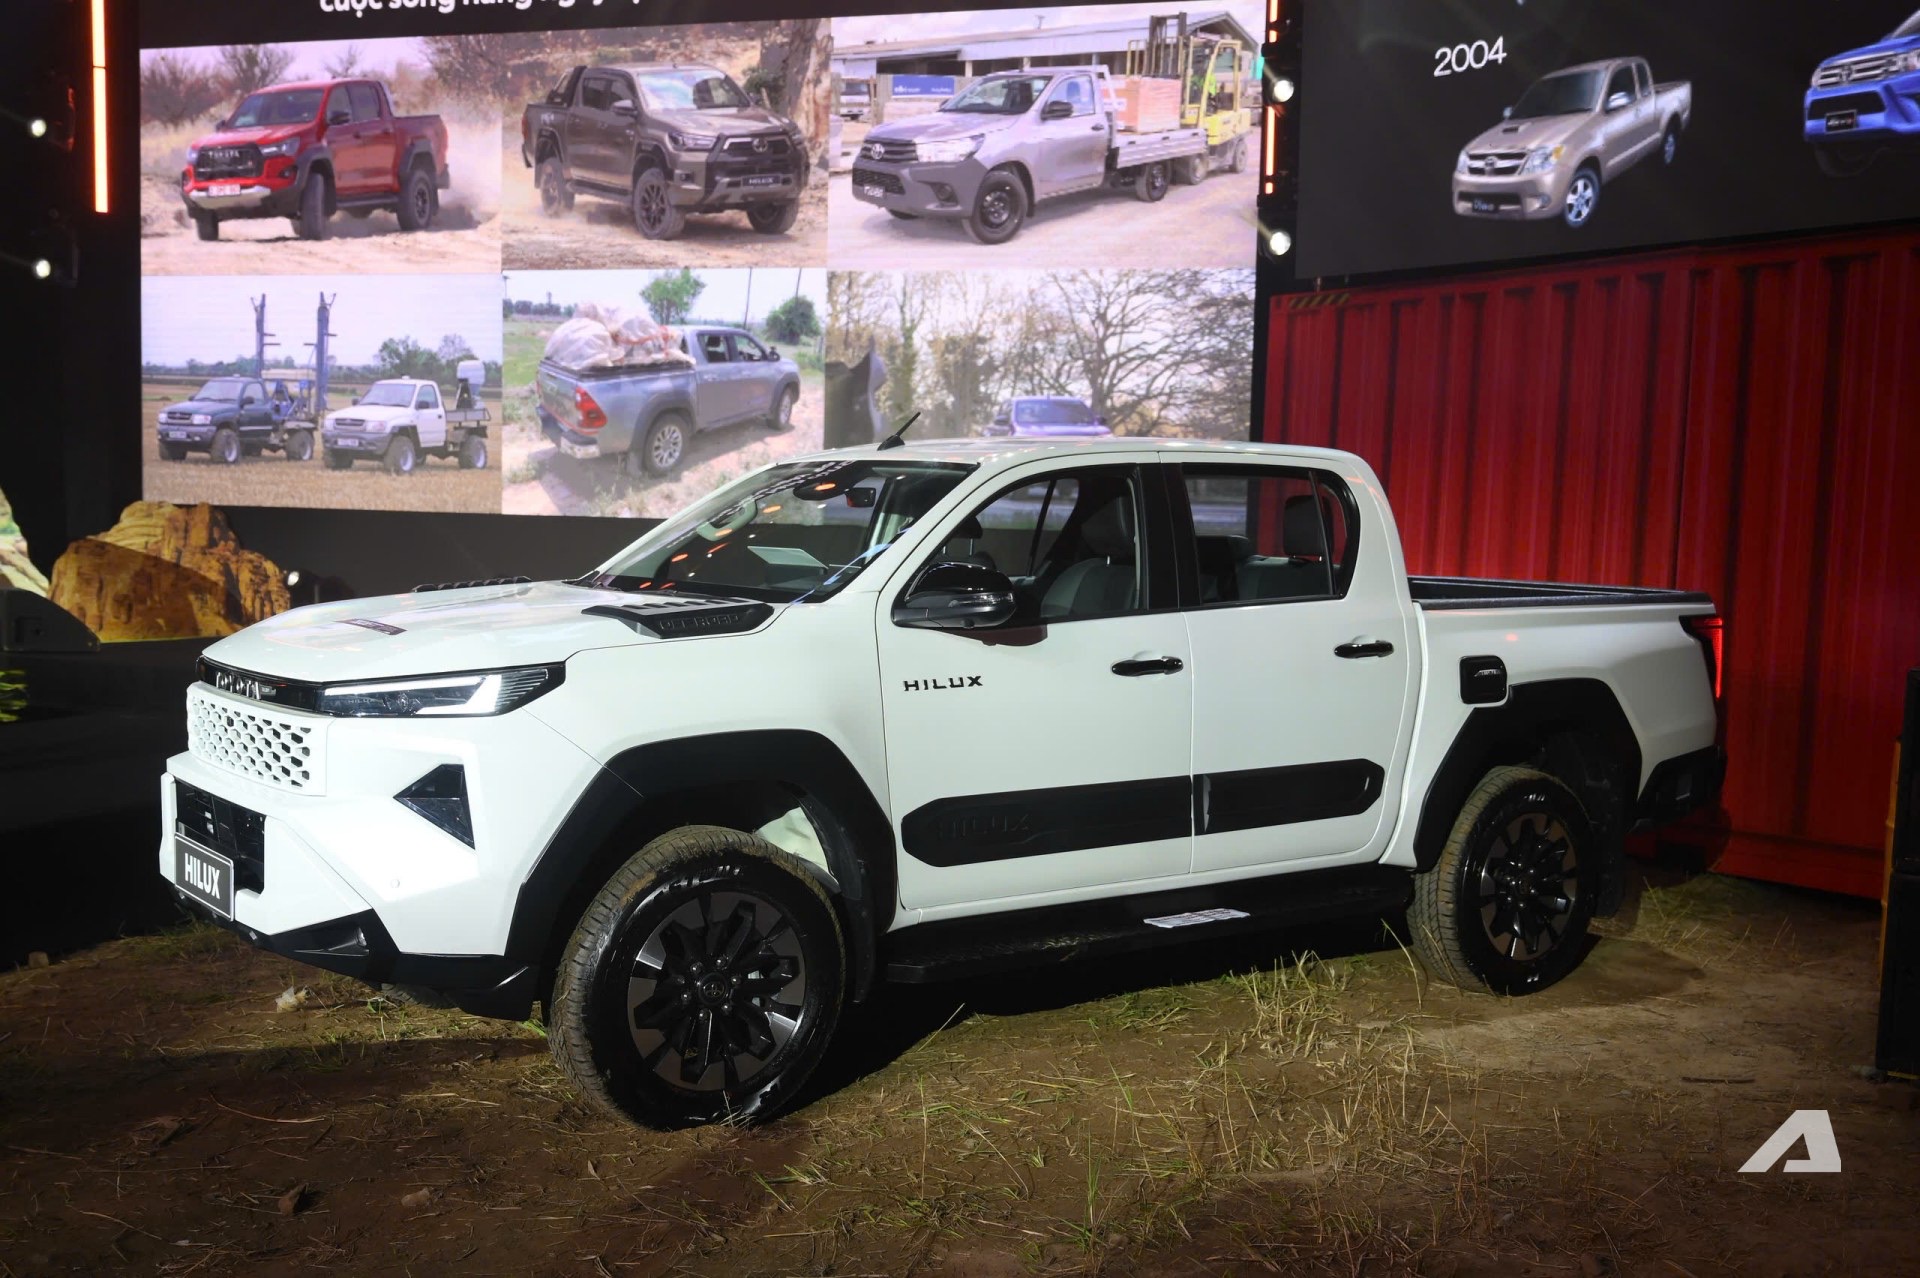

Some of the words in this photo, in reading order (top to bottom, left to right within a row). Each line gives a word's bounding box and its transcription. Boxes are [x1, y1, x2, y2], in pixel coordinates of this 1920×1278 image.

[1433, 35, 1507, 77] 2004
[903, 675, 983, 692] HILUX
[184, 852, 221, 900] HILUX
